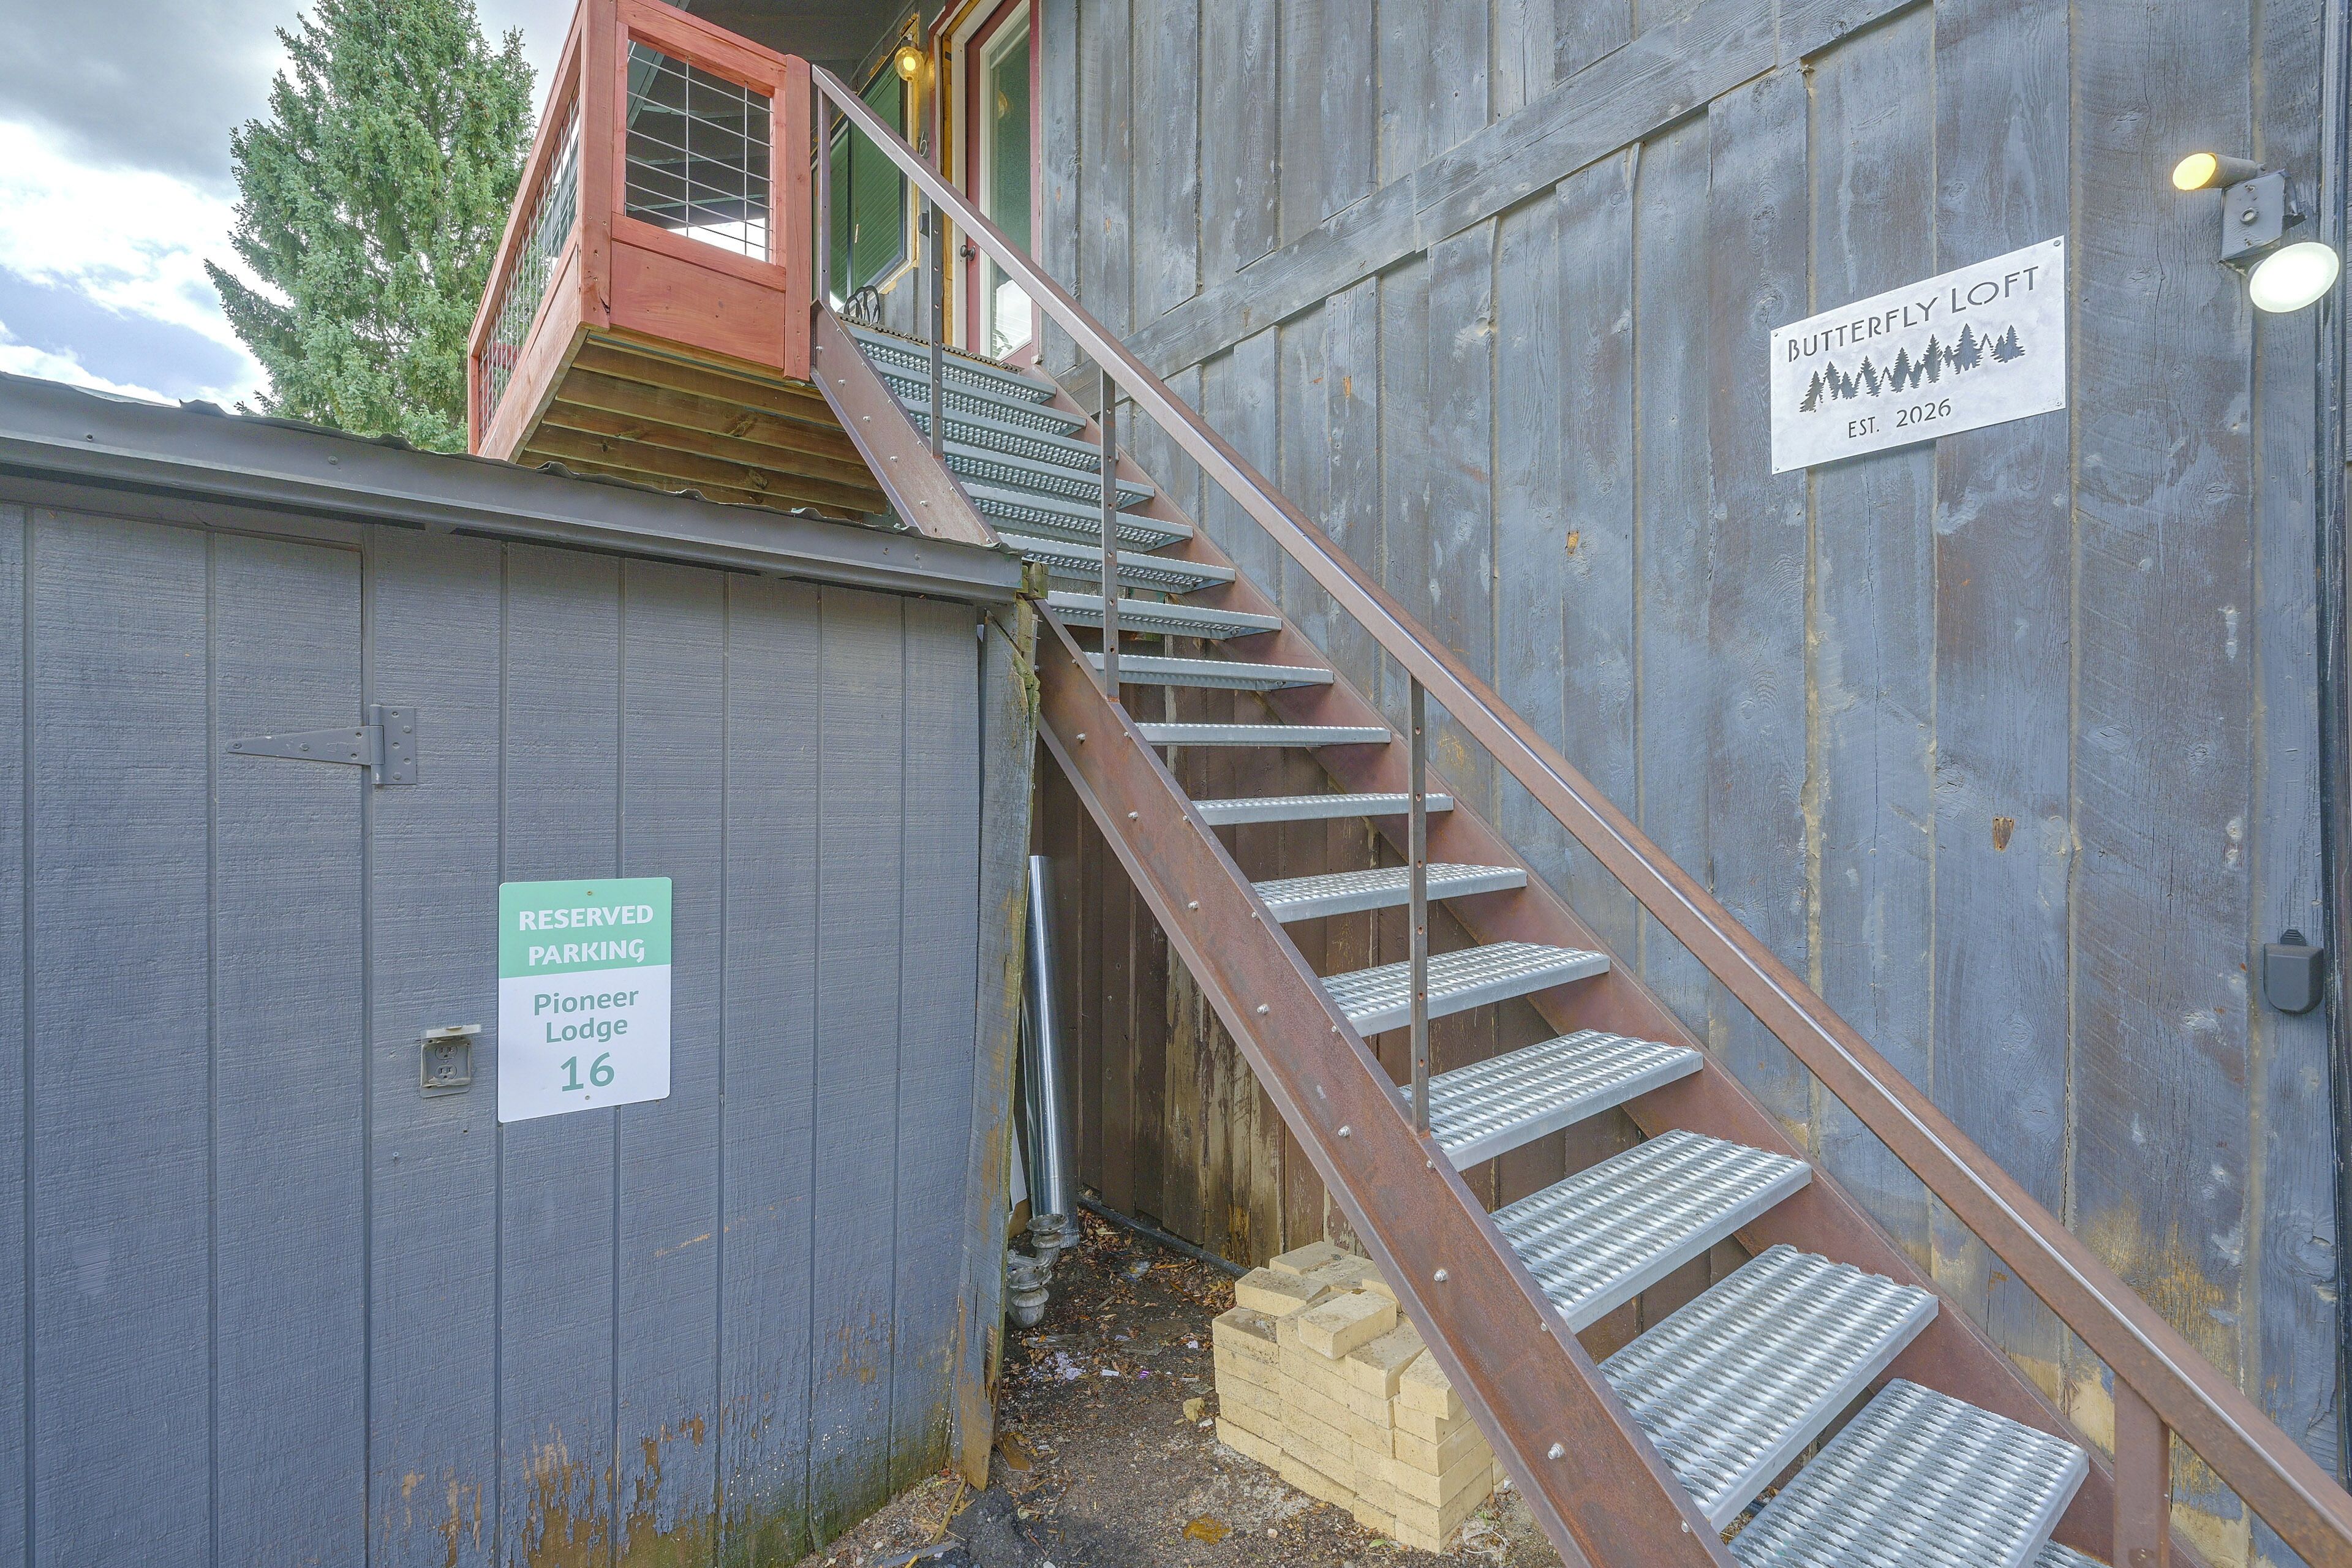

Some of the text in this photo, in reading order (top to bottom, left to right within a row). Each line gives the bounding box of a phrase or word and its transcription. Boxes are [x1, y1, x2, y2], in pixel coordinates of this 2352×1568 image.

[1788, 266, 2039, 363] BUTTERFLY LOFT
[1848, 398, 1952, 439] EST. 2026
[519, 905, 654, 931] RESERVED
[529, 939, 645, 967] PARKING
[534, 990, 639, 1016] Pioneer
[546, 1017, 628, 1043] Lodge
[560, 1052, 614, 1091] 16
